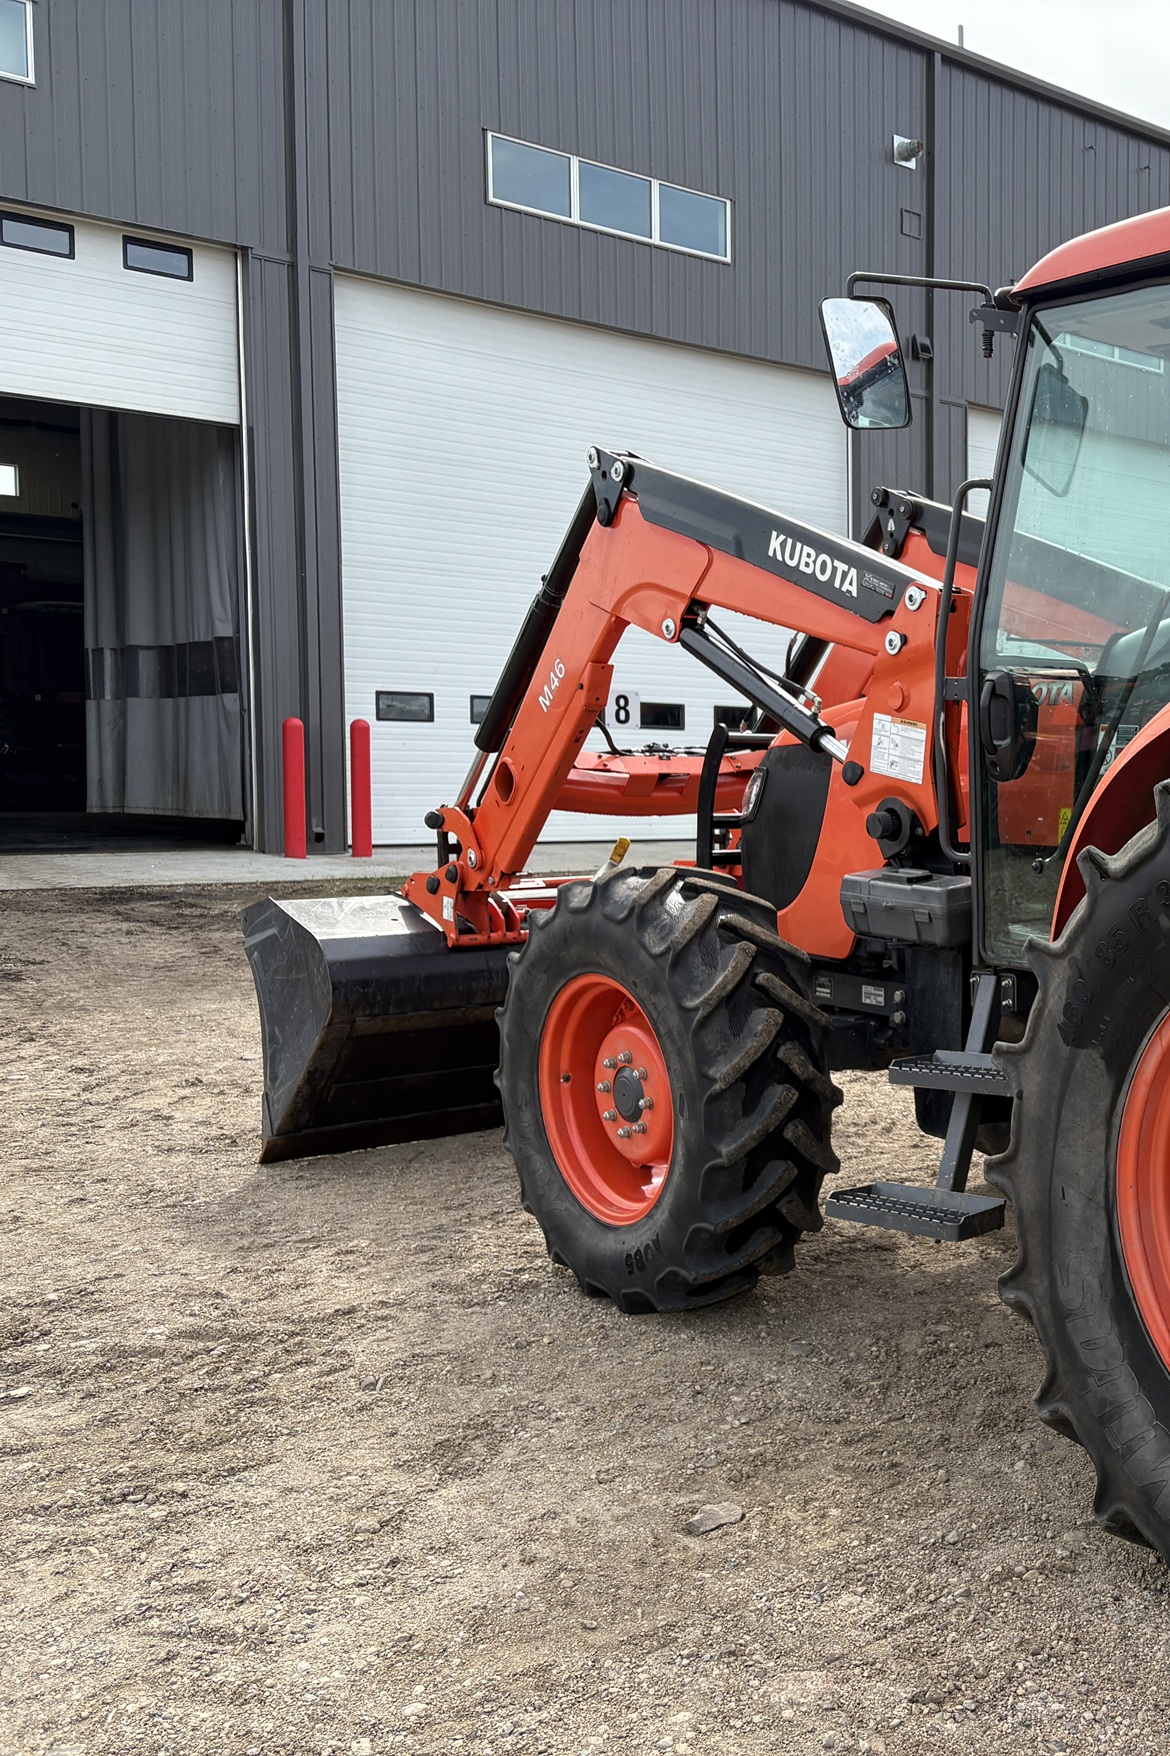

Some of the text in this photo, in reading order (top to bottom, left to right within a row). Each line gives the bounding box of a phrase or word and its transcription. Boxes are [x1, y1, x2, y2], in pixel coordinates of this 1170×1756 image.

[767, 530, 858, 598] KUBOTA
[538, 659, 565, 713] M46
[615, 694, 630, 725] 8
